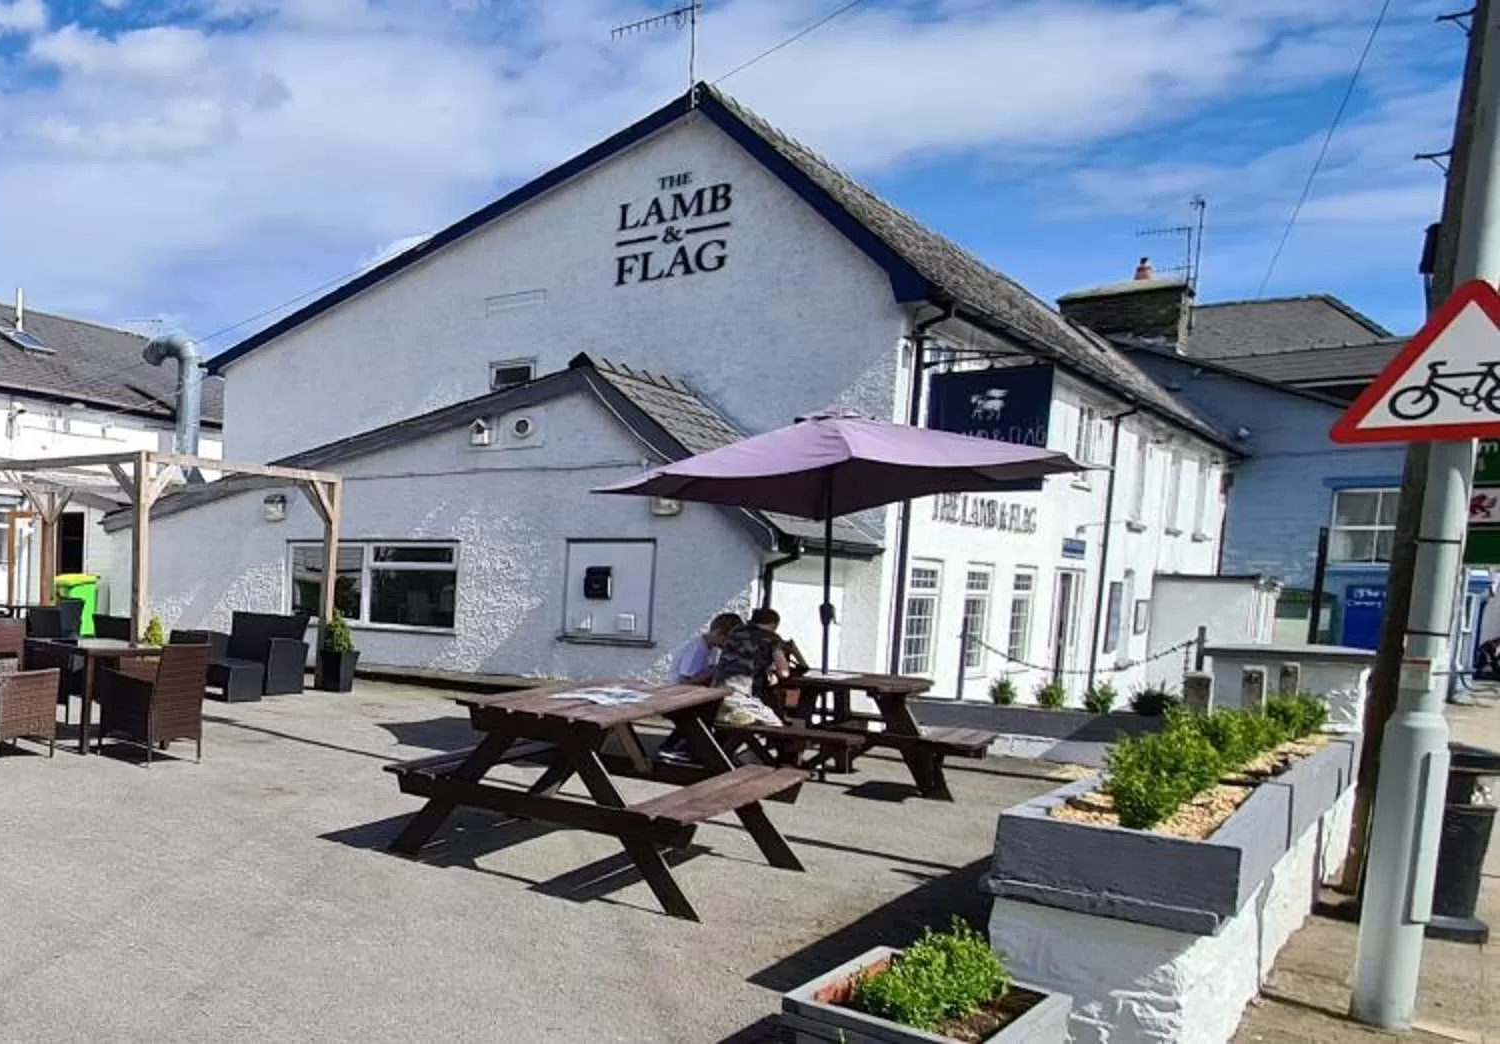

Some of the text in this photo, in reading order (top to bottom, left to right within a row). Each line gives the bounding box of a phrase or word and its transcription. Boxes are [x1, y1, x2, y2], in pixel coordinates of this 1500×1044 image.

[658, 172, 692, 190] THE
[617, 183, 732, 231] LAMB
[662, 226, 683, 244] &
[614, 239, 728, 286] FLAG
